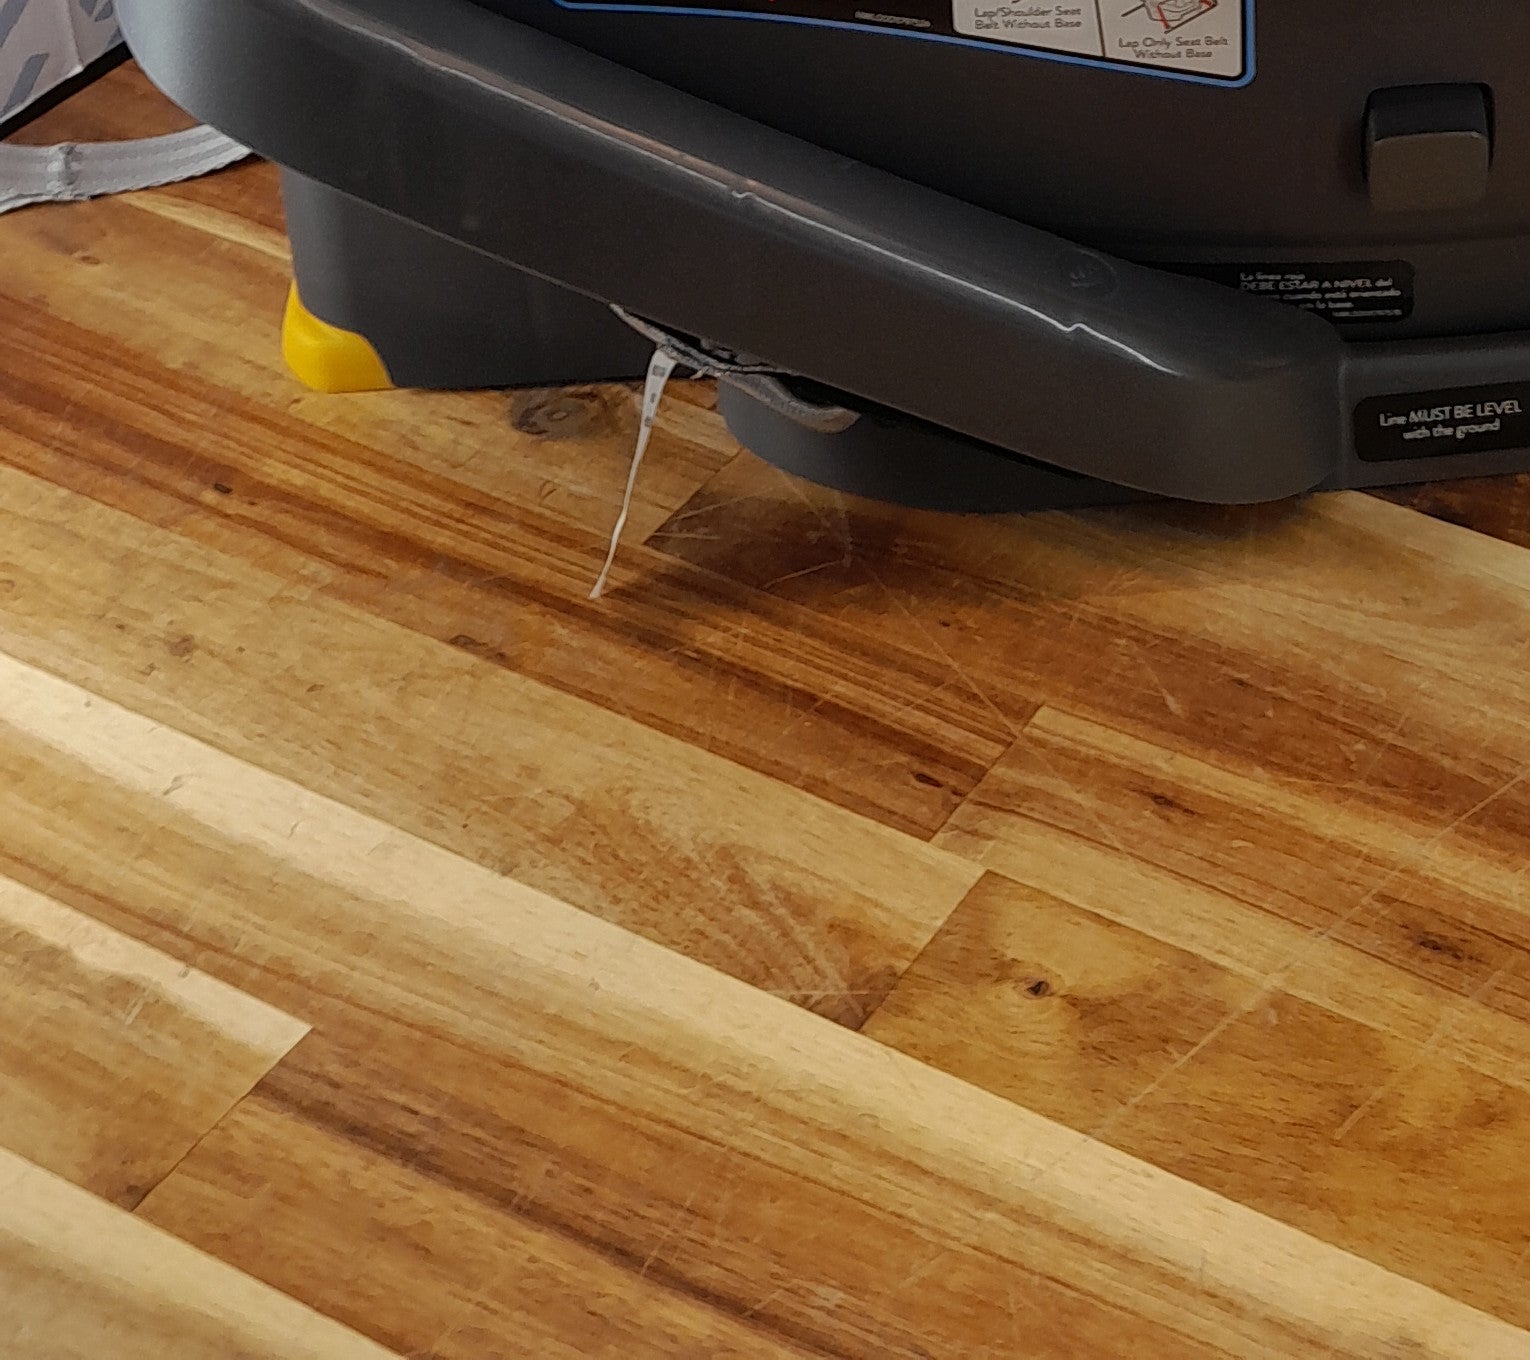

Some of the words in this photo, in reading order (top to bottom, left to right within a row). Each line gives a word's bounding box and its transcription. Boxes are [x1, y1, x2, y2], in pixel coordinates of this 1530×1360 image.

[1054, 5, 1081, 16] Seat
[974, 18, 999, 30] Belt
[1003, 18, 1051, 29] Without
[1054, 18, 1082, 28] Base
[1118, 37, 1138, 48] Lap
[1142, 36, 1172, 49] Only
[1175, 35, 1200, 47] Seat
[1204, 35, 1228, 46] Belt
[1133, 48, 1181, 59] Without
[1185, 48, 1213, 58] Base
[1378, 412, 1407, 426] Line
[1408, 405, 1451, 423] MUST
[1453, 403, 1473, 419] BE
[1475, 399, 1522, 416] LEVEL
[1455, 417, 1500, 439] ground
